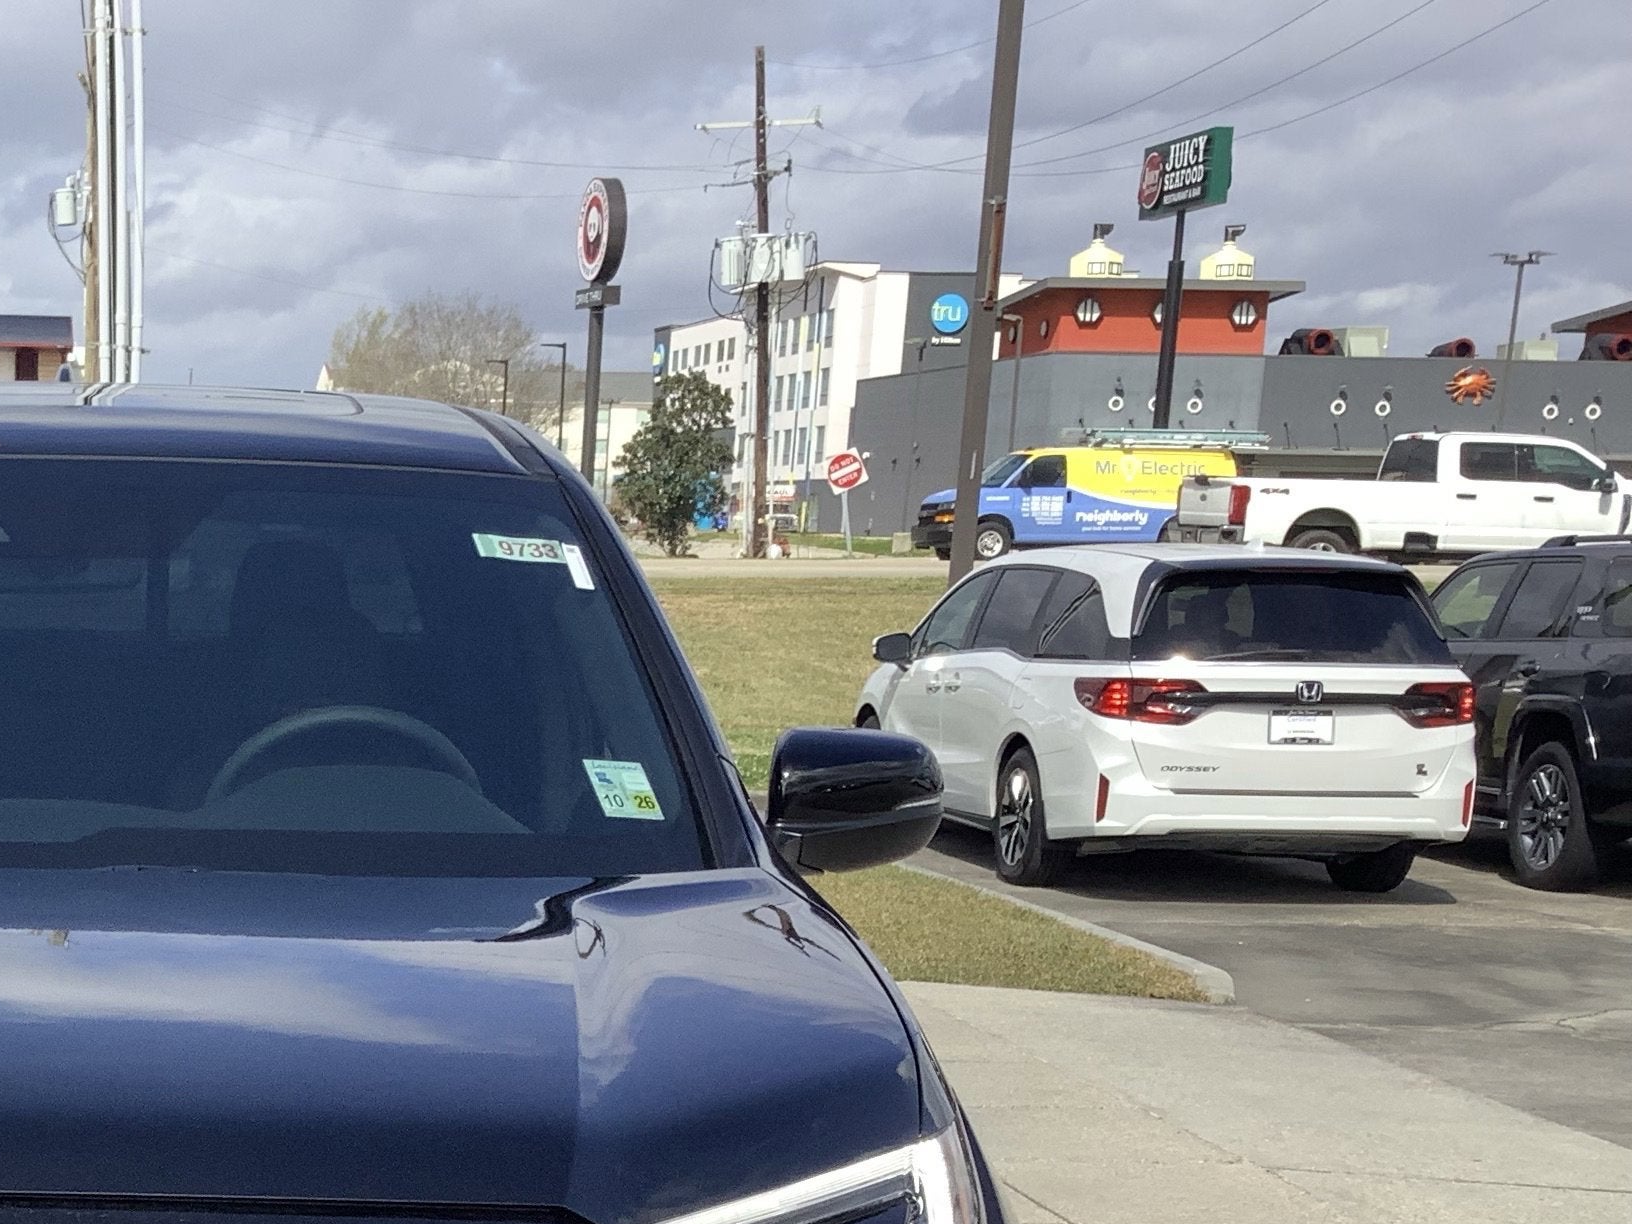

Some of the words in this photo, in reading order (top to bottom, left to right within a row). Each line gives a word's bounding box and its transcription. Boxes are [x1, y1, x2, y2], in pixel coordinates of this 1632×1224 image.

[1165, 135, 1208, 171] JUICY
[1163, 164, 1204, 191] SEAFOOD
[932, 302, 962, 322] tru
[829, 463, 840, 473] DO
[840, 456, 854, 467] NOT
[1095, 460, 1120, 475] Mr.
[1141, 461, 1206, 476] Electric
[837, 471, 859, 486] ENTER
[1075, 509, 1149, 526] neighborly
[498, 540, 559, 560] 9733
[1161, 765, 1220, 773] ODYSSEY
[603, 794, 625, 808] 10
[633, 795, 656, 810] 26
